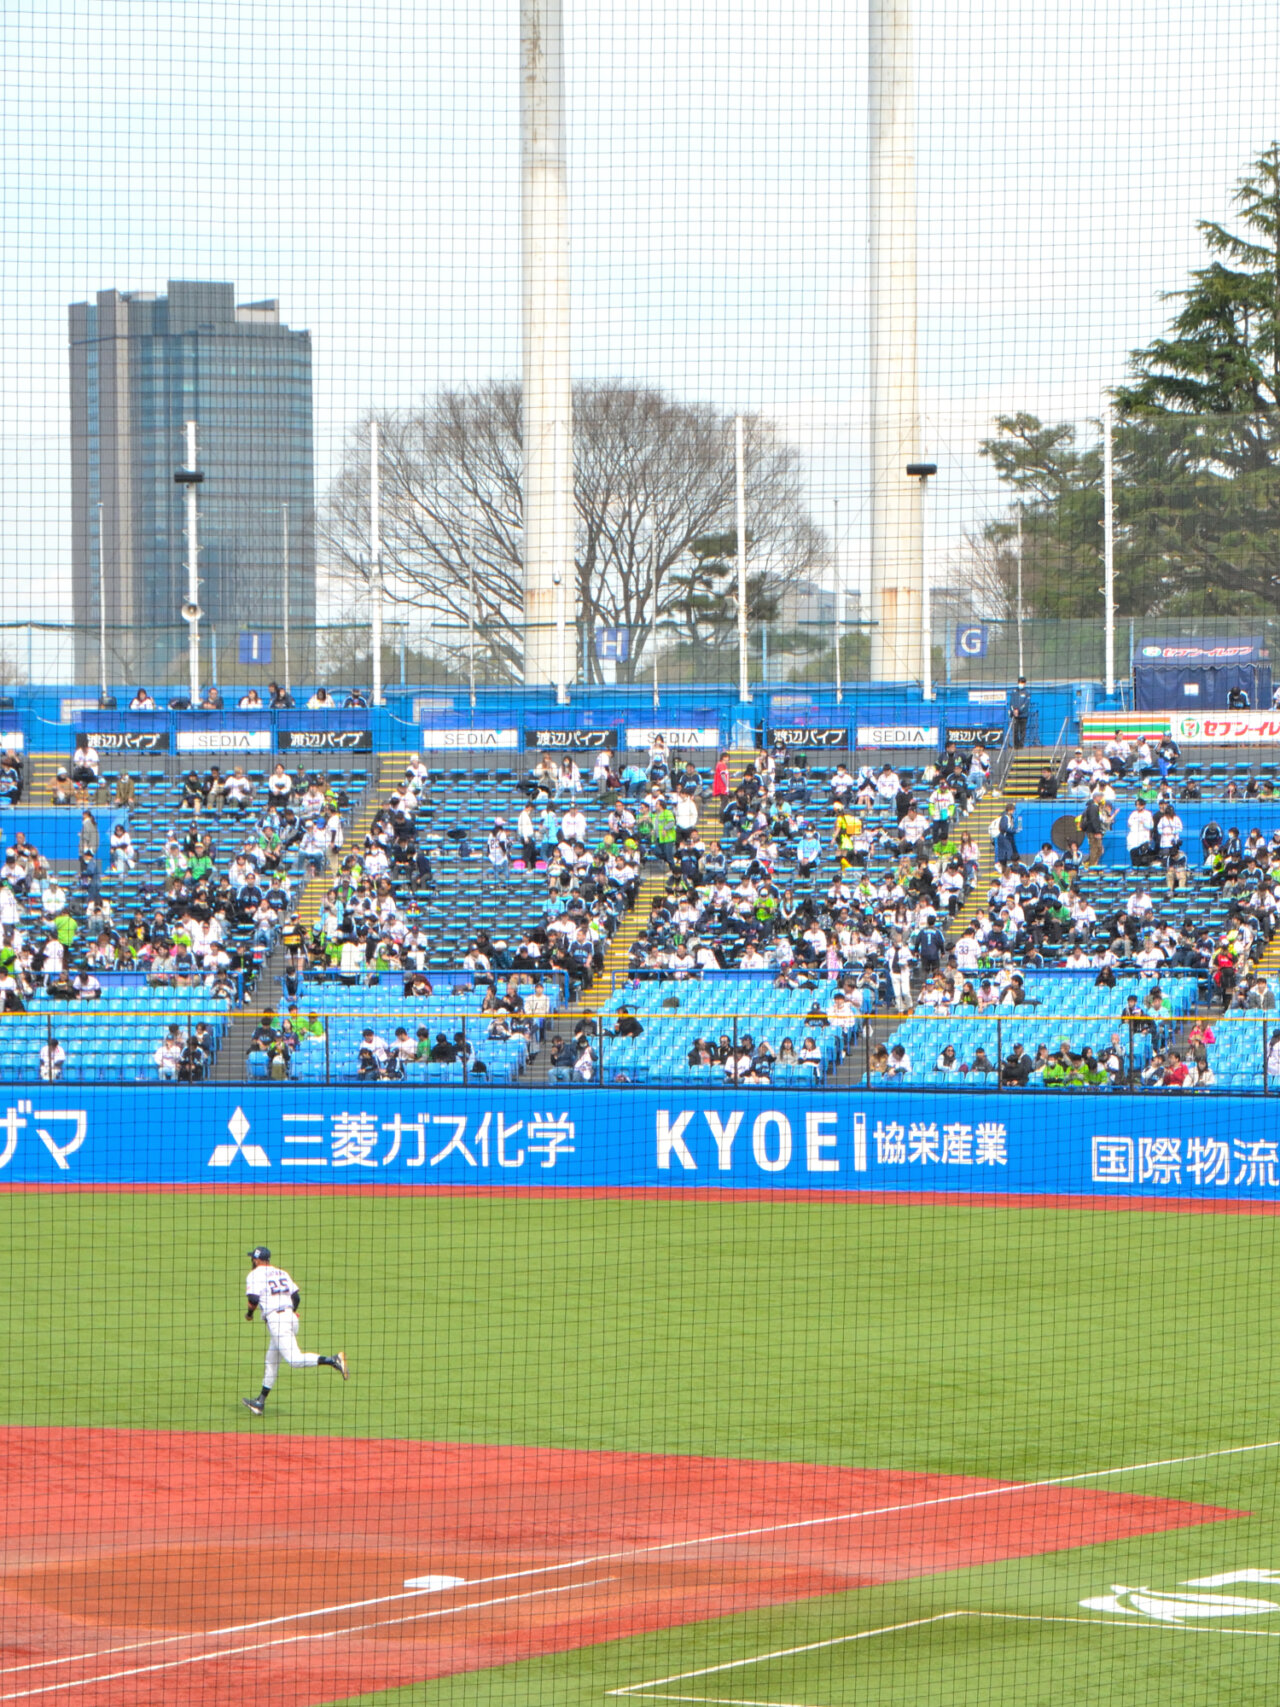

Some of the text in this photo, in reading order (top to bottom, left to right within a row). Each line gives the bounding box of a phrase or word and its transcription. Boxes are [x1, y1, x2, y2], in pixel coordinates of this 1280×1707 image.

[602, 631, 622, 656] H
[961, 628, 981, 653] G
[198, 735, 250, 748] SEDIA
[444, 732, 497, 745] SEDIA
[872, 730, 924, 742] SEDIA
[281, 1111, 576, 1168] 三菱ガス化学
[873, 1121, 1009, 1166] 協栄産業
[268, 1278, 289, 1295] 25
